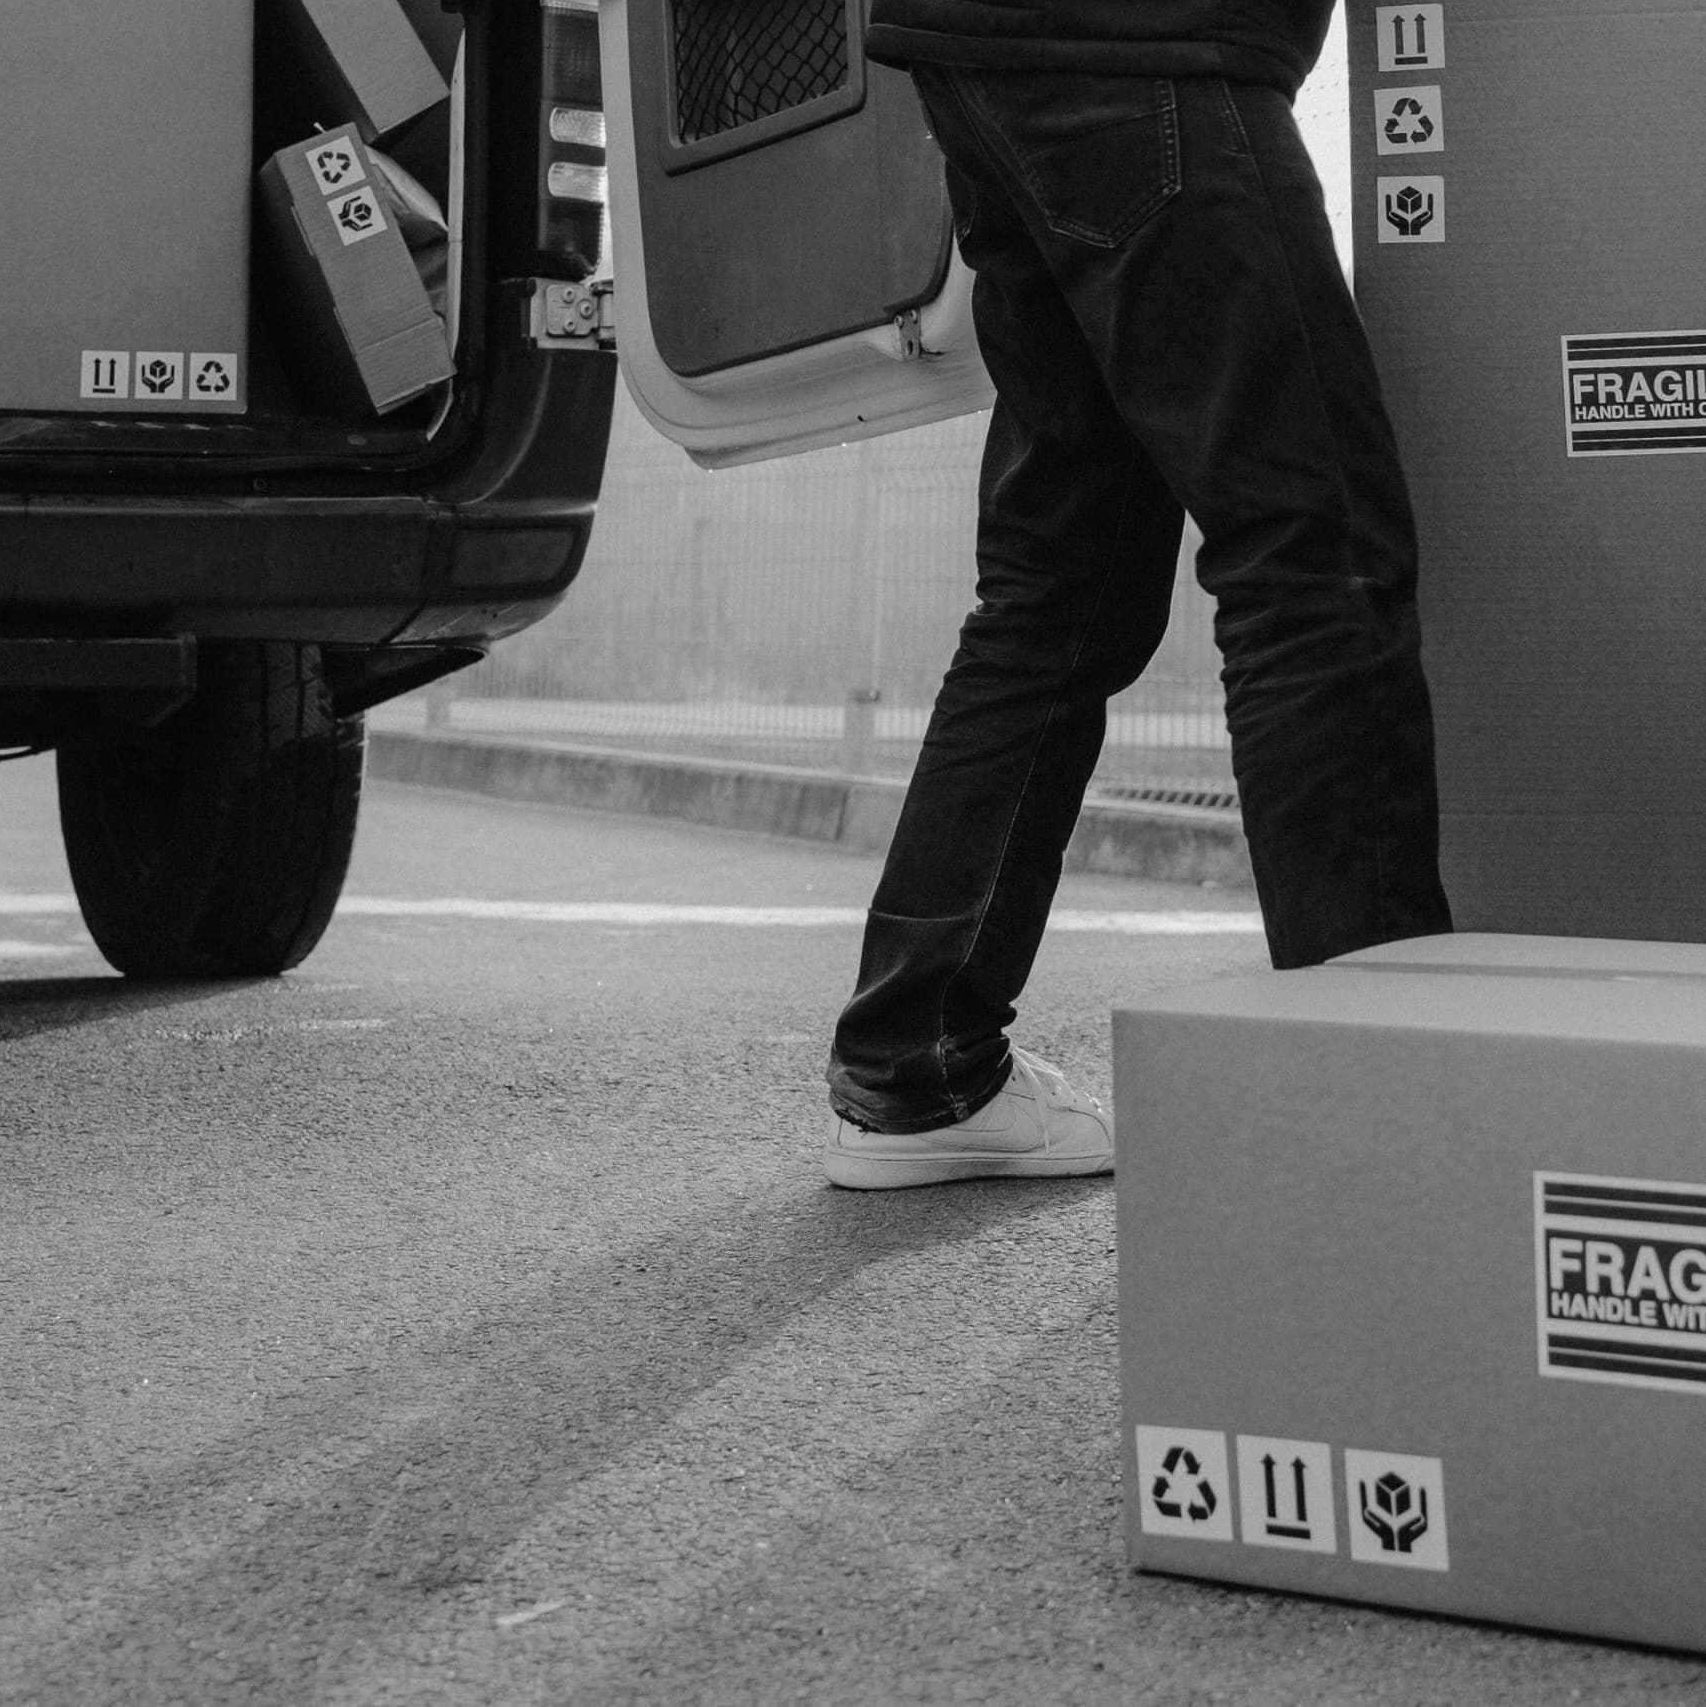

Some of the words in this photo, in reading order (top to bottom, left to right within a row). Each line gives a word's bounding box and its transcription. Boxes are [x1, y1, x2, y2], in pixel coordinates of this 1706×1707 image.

[1574, 403, 1646, 420] HANDLE
[1650, 402, 1694, 418] WITH
[1551, 1291, 1658, 1326] HANDLE
